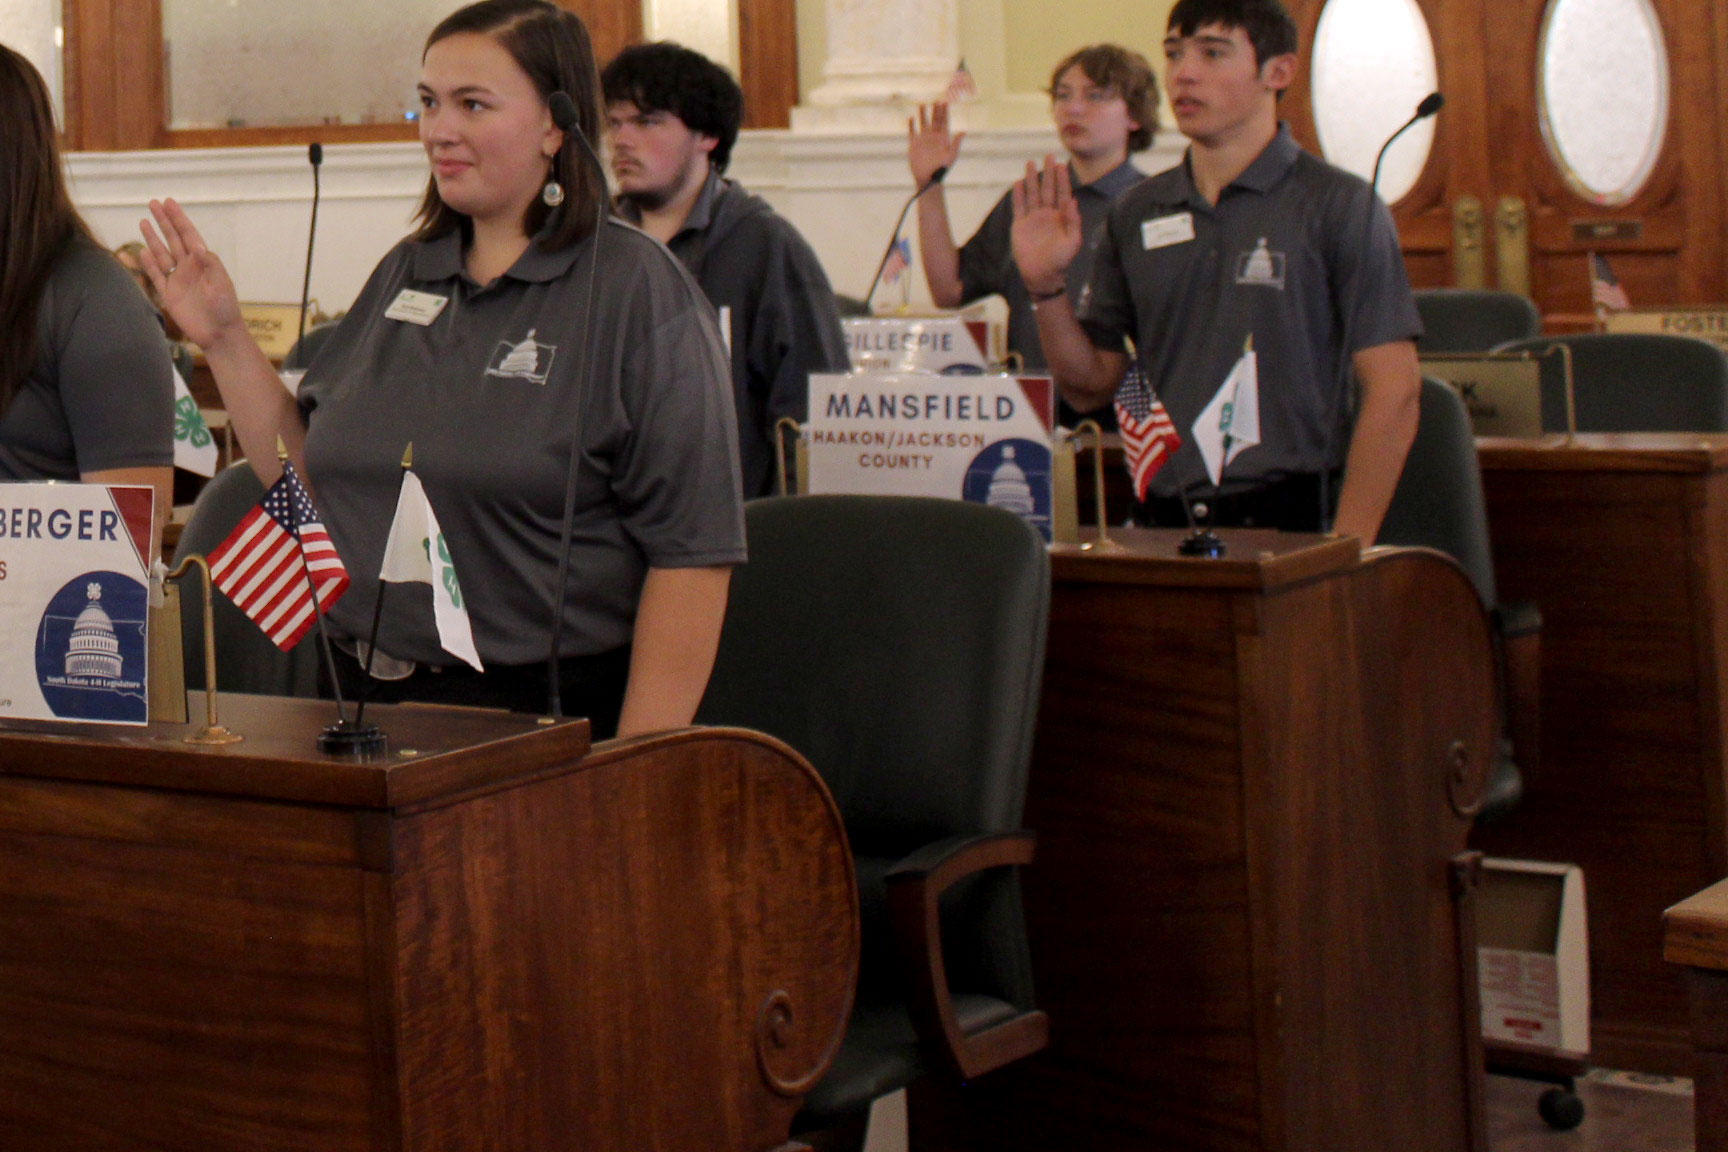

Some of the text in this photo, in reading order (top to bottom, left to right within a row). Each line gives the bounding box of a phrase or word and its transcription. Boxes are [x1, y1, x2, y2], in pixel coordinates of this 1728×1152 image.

[825, 393, 1016, 421] MANSFIELD
[813, 430, 986, 450] HAAKON/JACKSON
[858, 453, 934, 470] COUNTY
